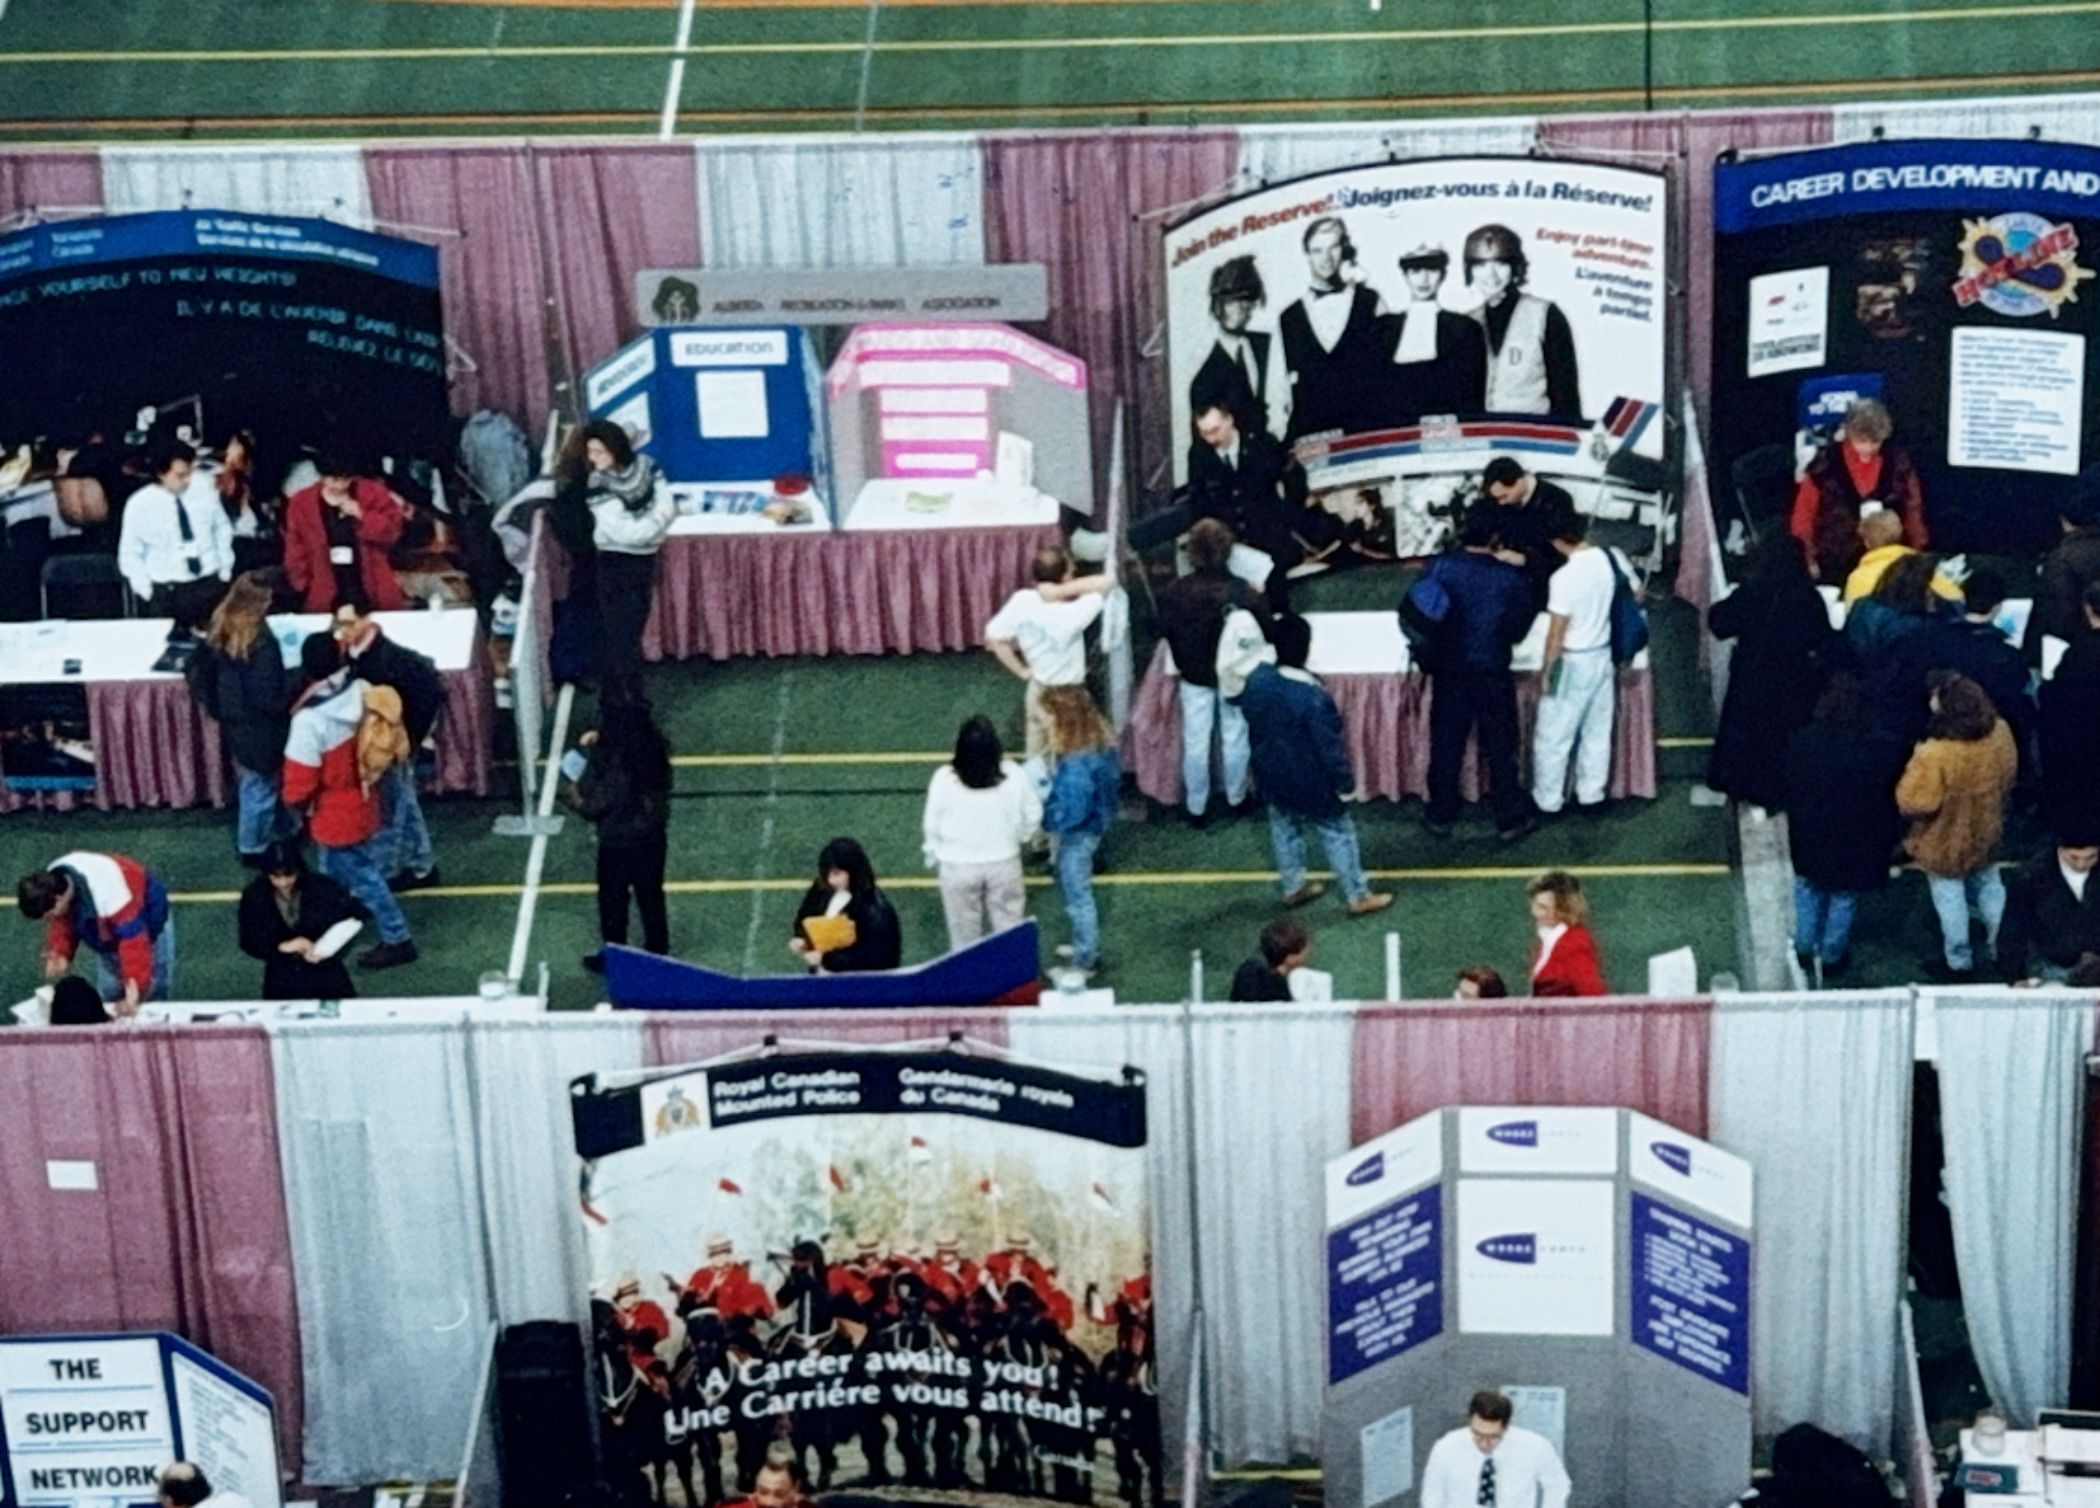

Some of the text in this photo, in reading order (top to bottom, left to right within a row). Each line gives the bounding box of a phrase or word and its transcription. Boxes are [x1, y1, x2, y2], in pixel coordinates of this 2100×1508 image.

[1345, 180, 1653, 212] Joignez-vous à la Réserve!
[1751, 164, 2099, 207] CAREER DEVELOPMENT AND
[1172, 193, 1334, 269] Join the Reserve!
[1536, 227, 1582, 247] Enjoy
[139, 269, 161, 285] TO
[685, 342, 774, 357] EDUCATION
[714, 1069, 861, 1100] Royal Canadian
[899, 1067, 1075, 1109] Gendarmerie royale
[715, 1088, 861, 1117] Mounted Police
[900, 1087, 1001, 1113] du Canada
[49, 1357, 103, 1380] THE
[705, 1347, 1060, 1394] A Career awaits you!
[26, 1409, 149, 1435] SUPPORT
[663, 1404, 731, 1435] Une
[892, 1382, 970, 1409] vous
[980, 1387, 1098, 1433] attend!
[31, 1465, 160, 1488] NETWORK
